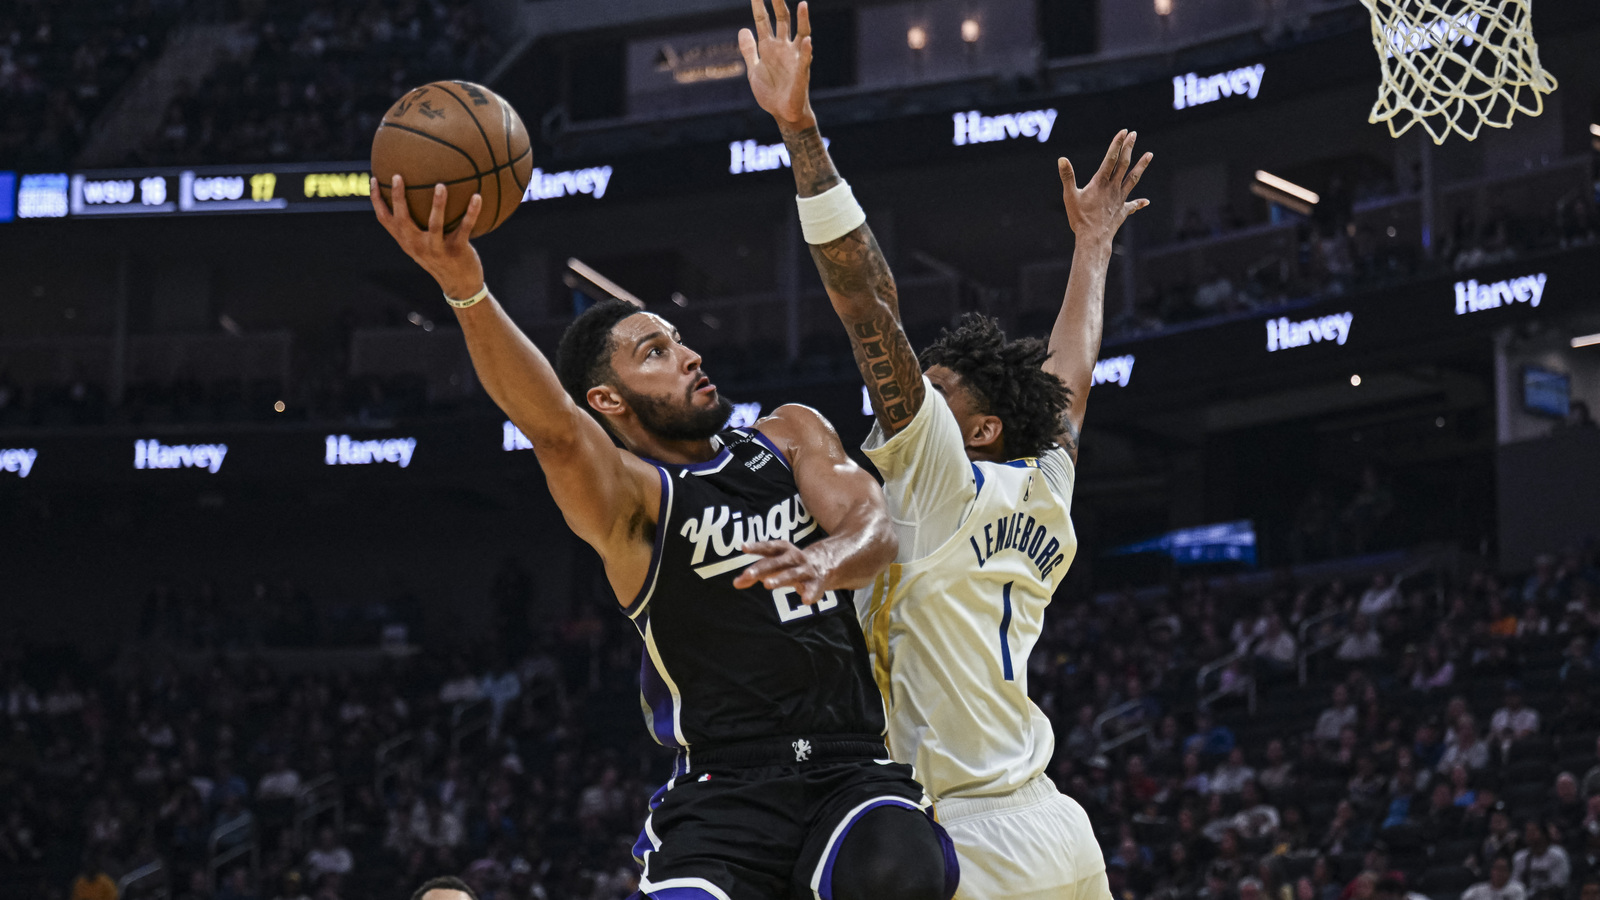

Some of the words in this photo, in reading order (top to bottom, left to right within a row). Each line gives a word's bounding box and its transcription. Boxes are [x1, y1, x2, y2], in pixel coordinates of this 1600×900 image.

[1172, 63, 1265, 110] Harvey
[952, 108, 1058, 145] Harvey
[1453, 272, 1548, 315] Harvey
[1265, 311, 1354, 352] Harvey
[1091, 354, 1135, 387] vey
[133, 439, 229, 474] Harvey
[324, 434, 417, 468] Harvey
[744, 450, 765, 468] Sutter
[750, 453, 773, 472] Health
[999, 580, 1014, 681] 1
